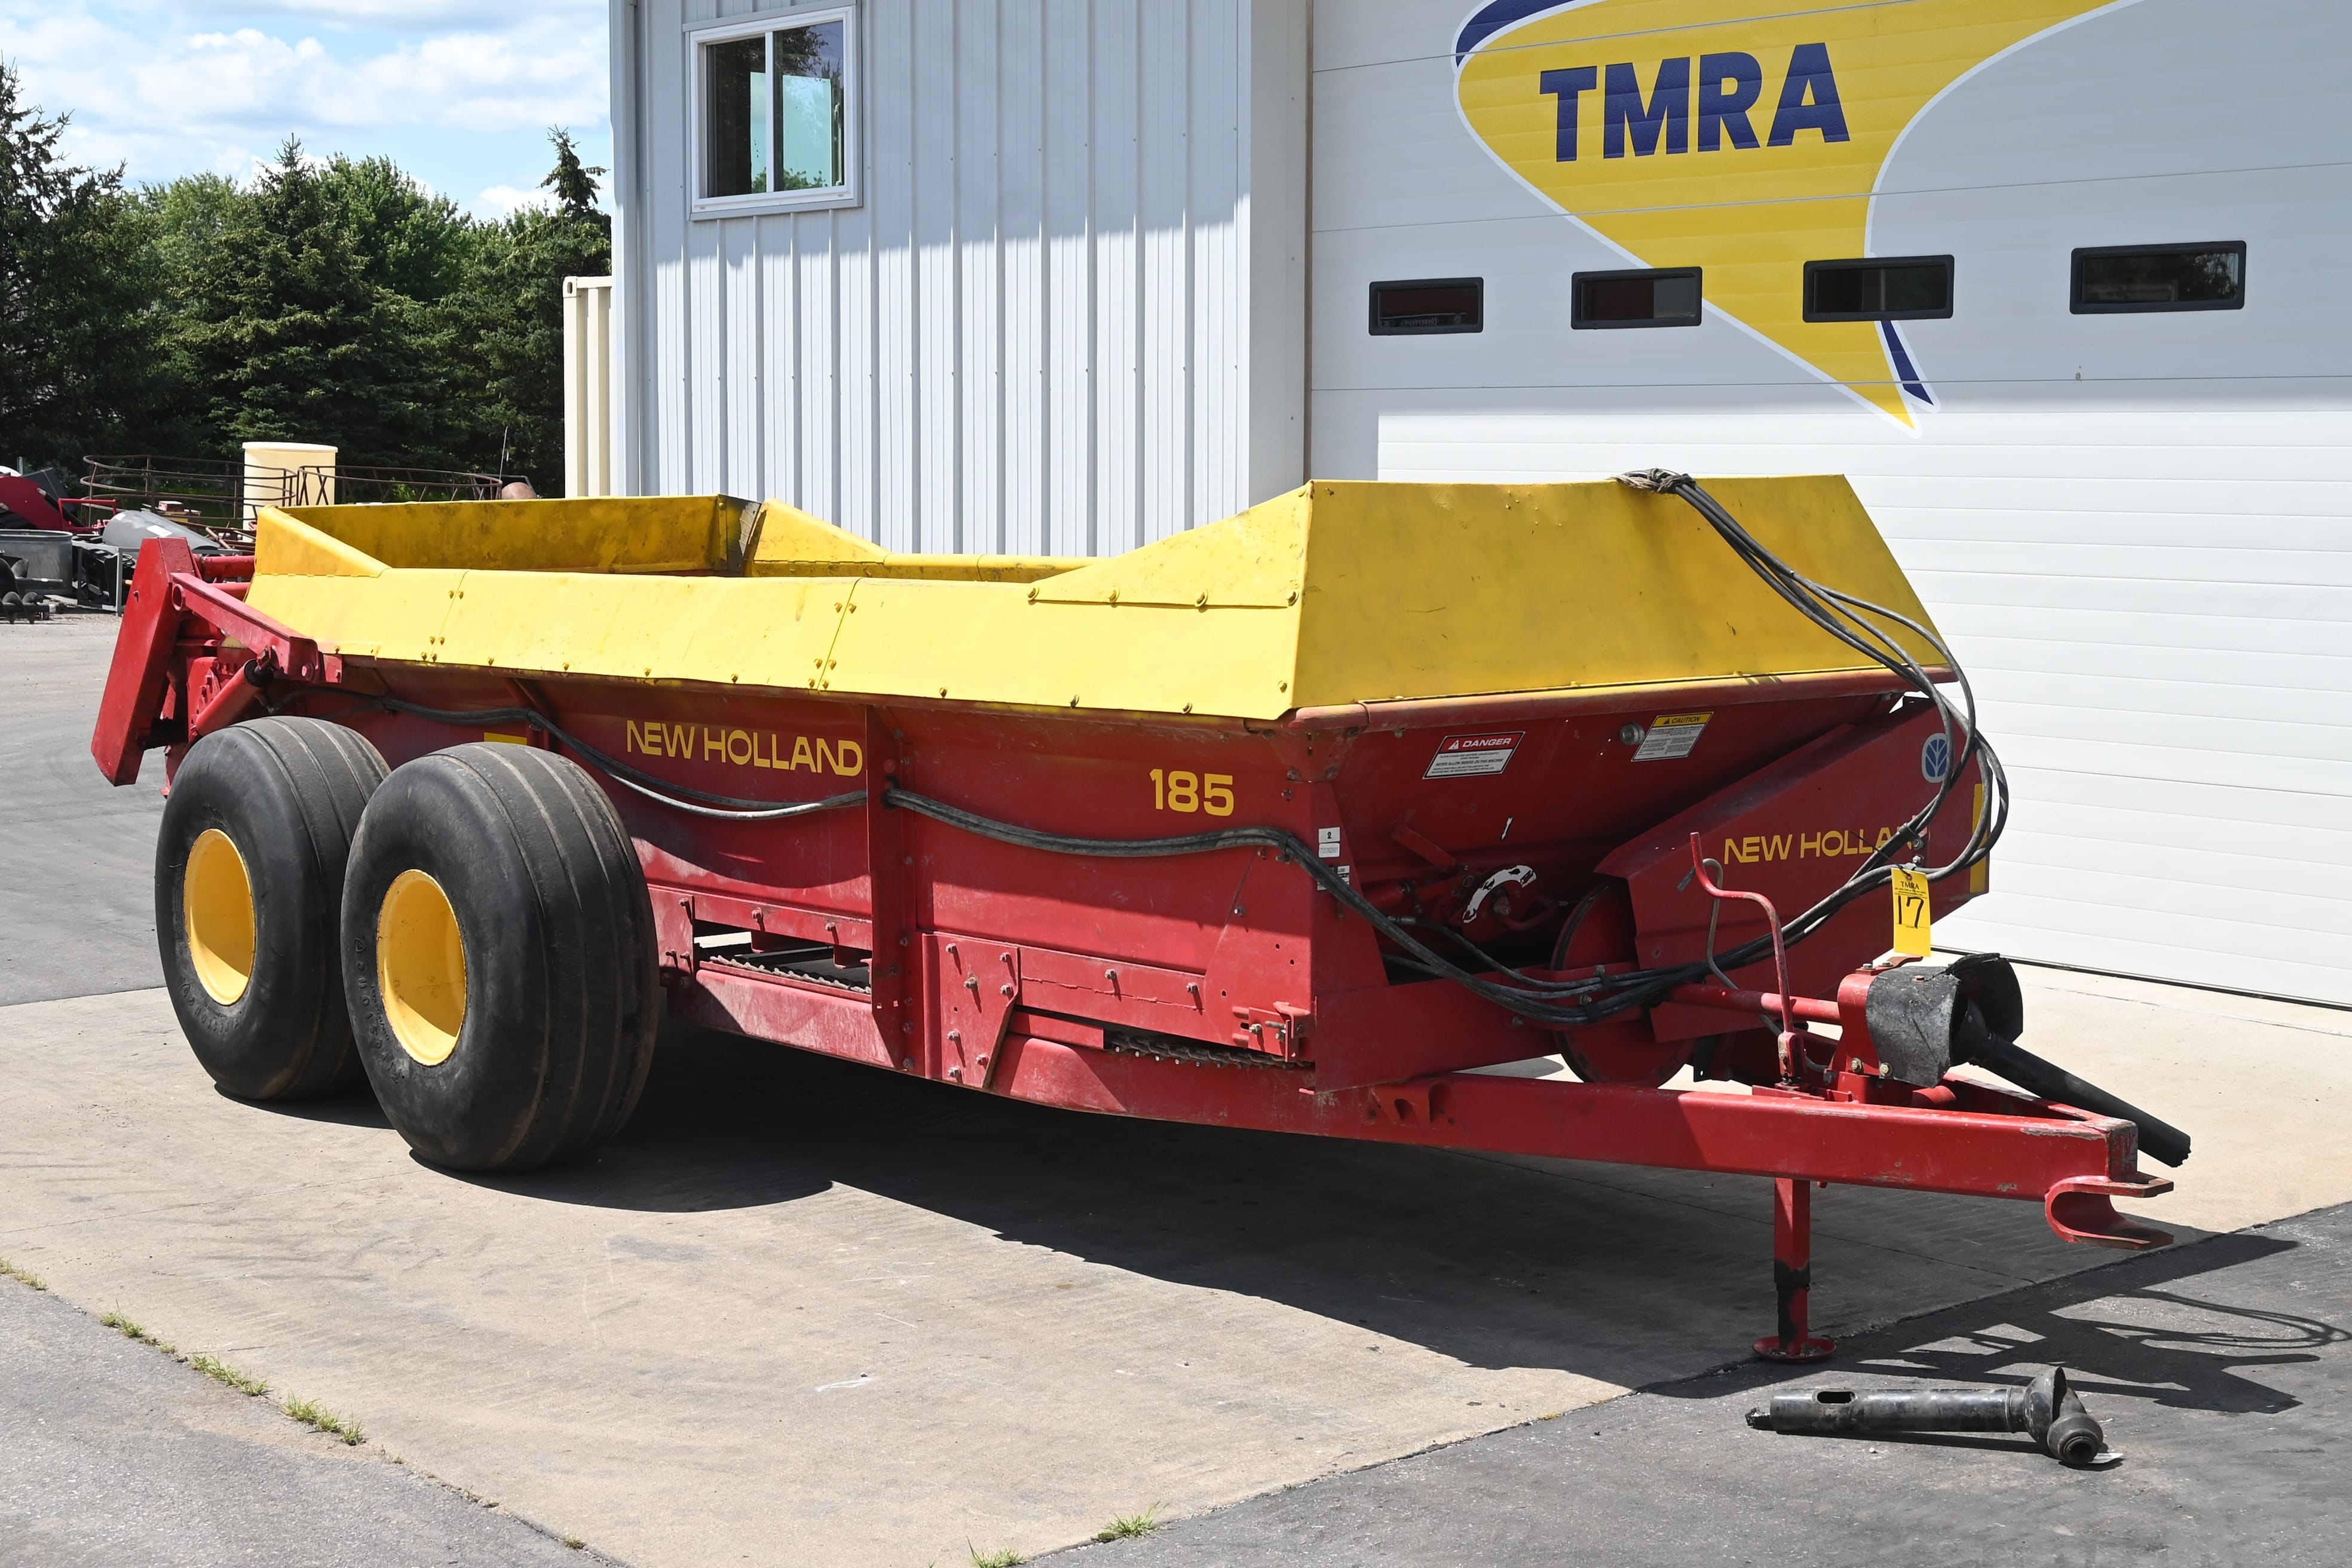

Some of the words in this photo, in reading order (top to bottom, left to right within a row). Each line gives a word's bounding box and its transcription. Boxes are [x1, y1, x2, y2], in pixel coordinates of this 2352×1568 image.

[1540, 42, 1850, 162] TMRA
[627, 719, 695, 759] NEW
[704, 727, 863, 777] HOLLAND
[1462, 738, 1512, 748] DANGER
[1149, 768, 1235, 816] 185
[1724, 834, 1793, 865] NEW
[1800, 826, 1912, 859] HOLLA
[1900, 881, 1919, 890] TMRA
[1898, 895, 1924, 929] 17
